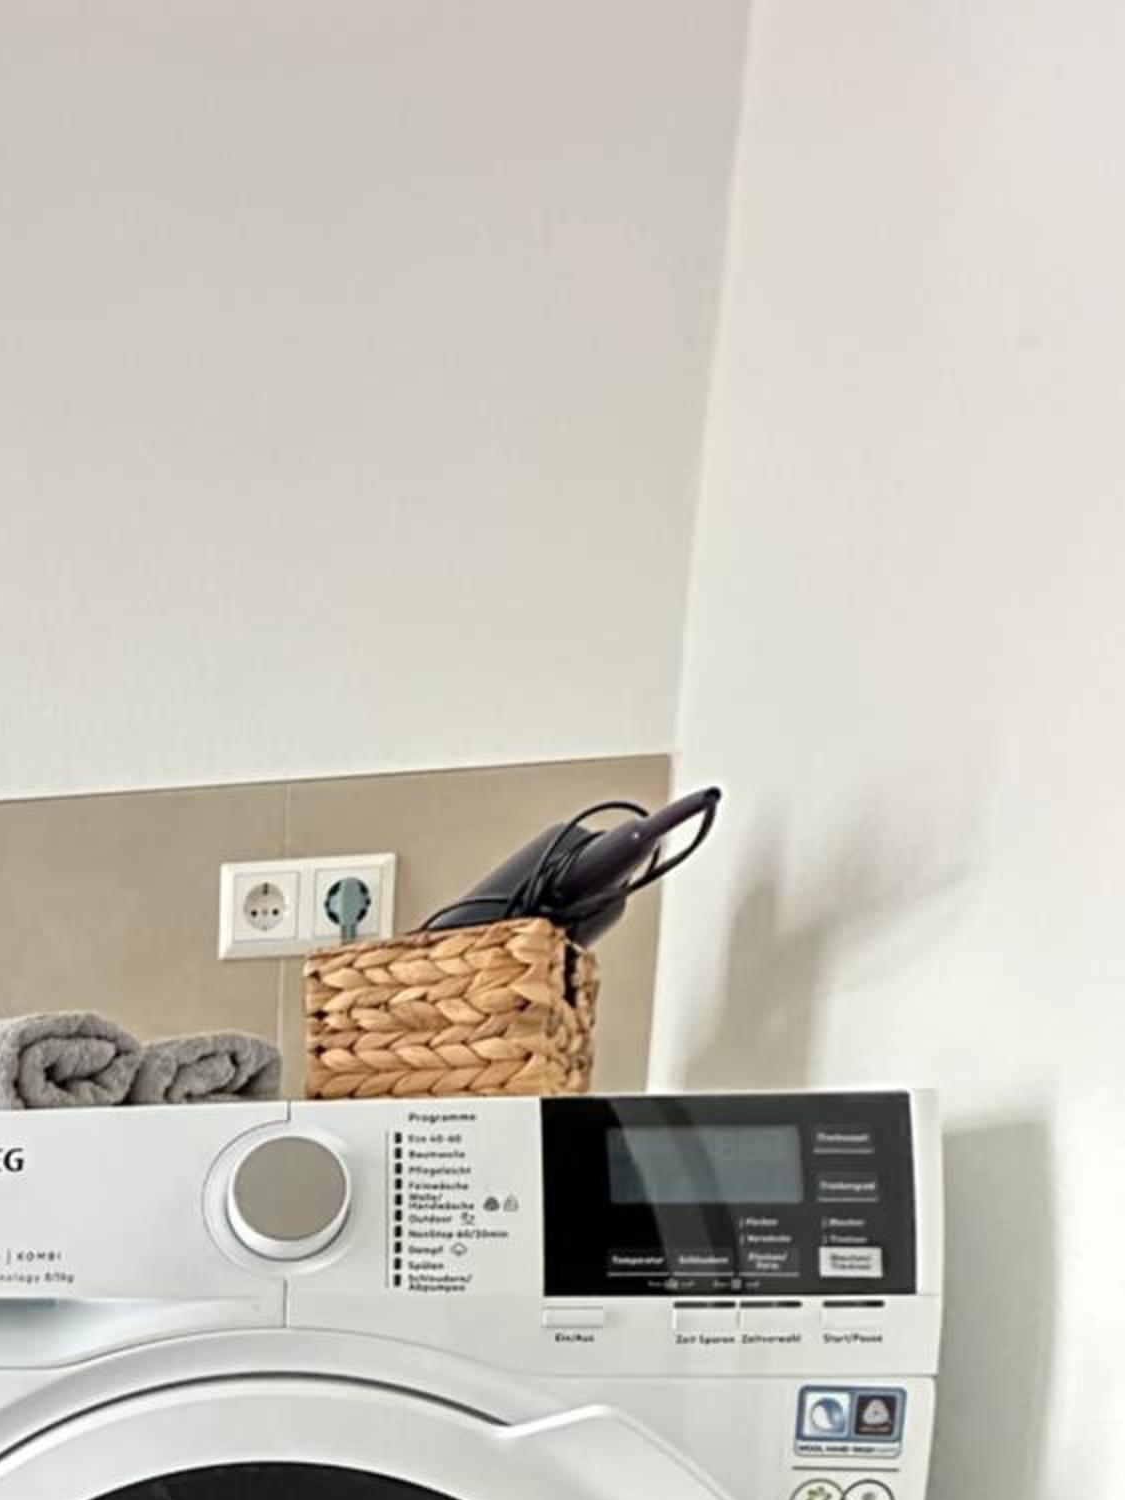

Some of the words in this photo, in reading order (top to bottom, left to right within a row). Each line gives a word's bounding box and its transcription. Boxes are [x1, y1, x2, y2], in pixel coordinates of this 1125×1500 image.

[408, 1112, 476, 1124] Programme
[408, 1213, 452, 1223] Outdoor
[16, 1251, 62, 1262] KOMBI
[408, 1245, 443, 1257] Dampf
[823, 1331, 883, 1344] Start/Pause
